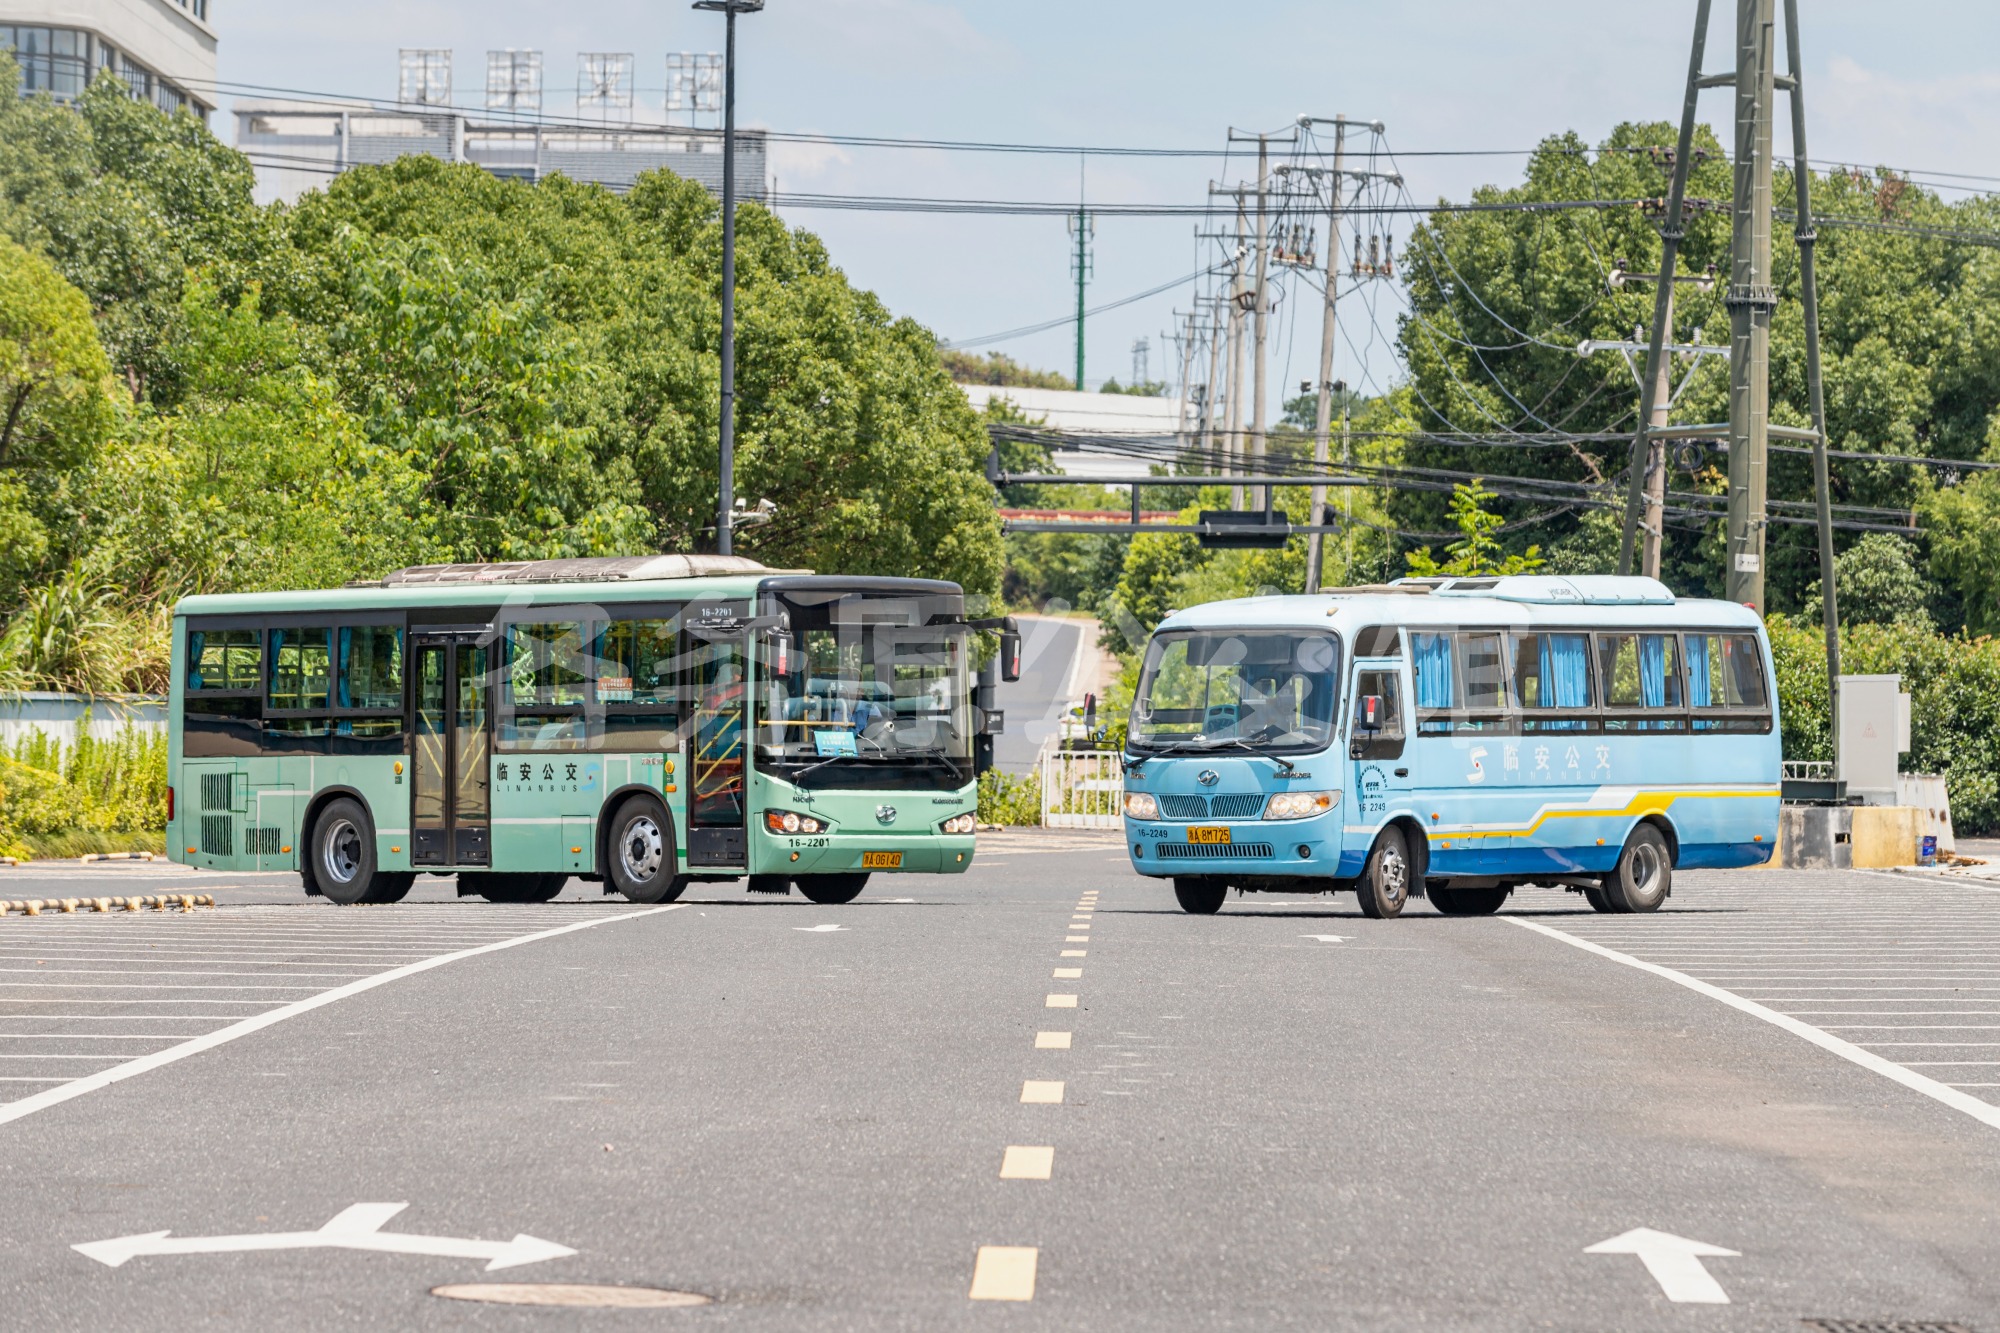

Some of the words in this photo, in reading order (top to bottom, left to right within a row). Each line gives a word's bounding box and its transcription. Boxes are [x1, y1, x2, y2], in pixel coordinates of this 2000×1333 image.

[701, 607, 732, 617] 16-2201
[1503, 744, 1611, 771] 临安公交
[496, 762, 578, 781] 临安公交
[1503, 770, 1612, 781] LINANBUS
[496, 784, 578, 792] LINANBUS
[1359, 803, 1366, 812] 16
[1370, 802, 1386, 812] 2249
[1137, 828, 1168, 839] 16-2249
[788, 838, 831, 848] 16-2201
